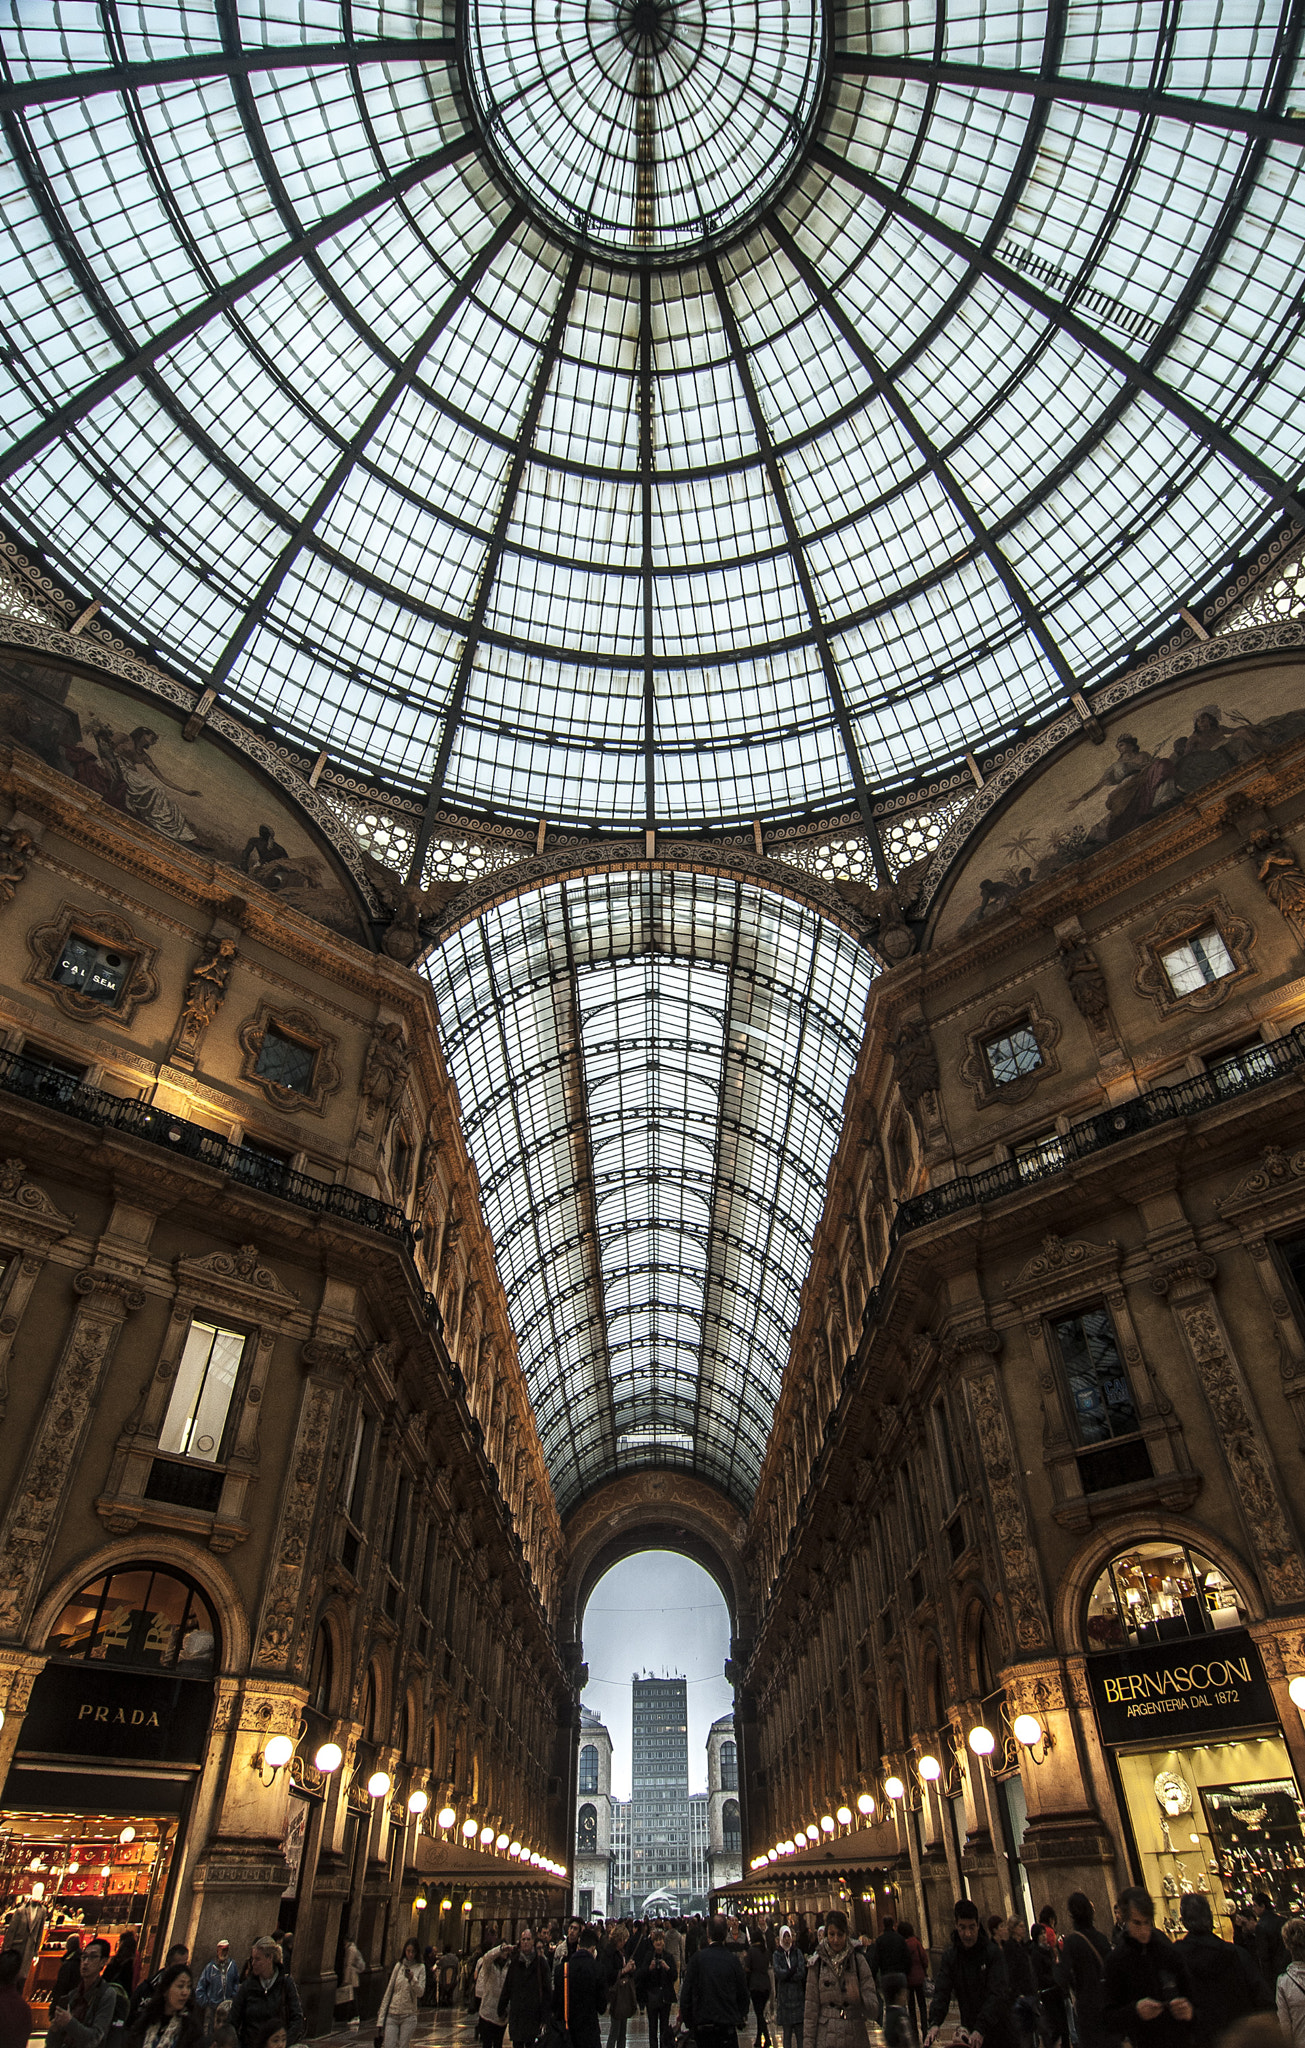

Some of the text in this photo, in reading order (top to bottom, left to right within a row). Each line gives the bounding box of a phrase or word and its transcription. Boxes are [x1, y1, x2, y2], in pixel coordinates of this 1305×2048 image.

[1103, 1657, 1253, 1703] BERNASCONI
[78, 1704, 160, 1727] PRADA
[1127, 1689, 1240, 1718] ARGENTERIA DAL 1872
